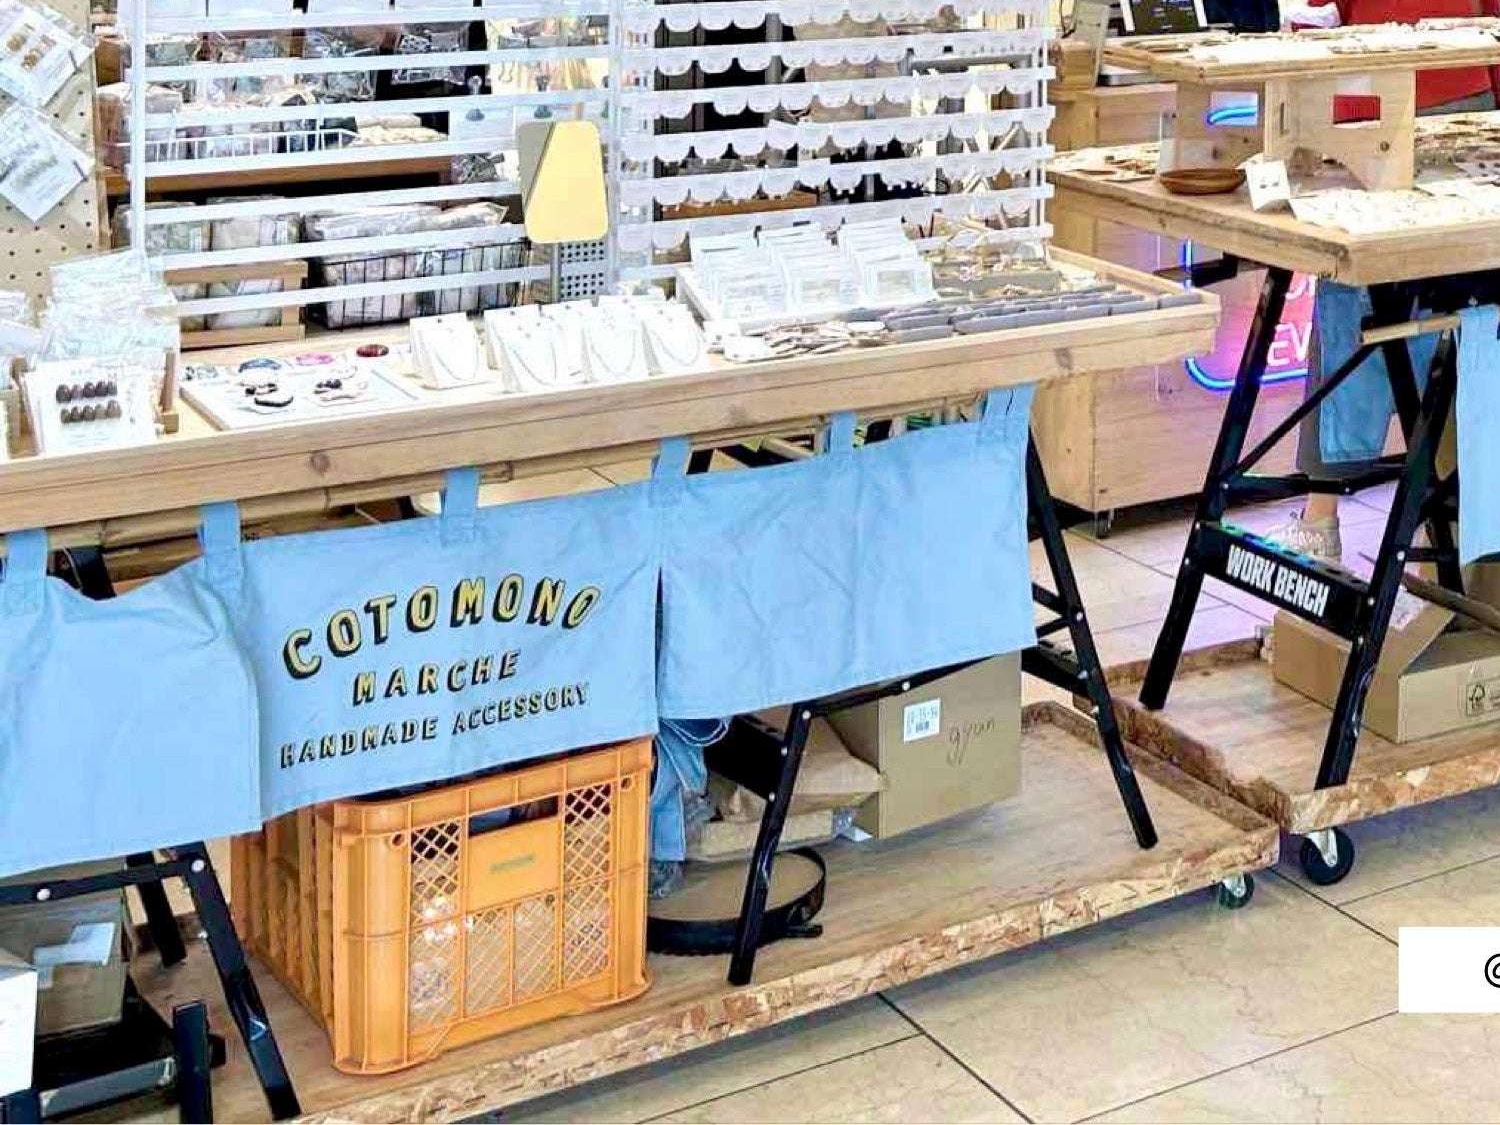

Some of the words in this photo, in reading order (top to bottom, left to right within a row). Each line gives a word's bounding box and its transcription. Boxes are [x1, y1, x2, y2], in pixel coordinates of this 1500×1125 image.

[1225, 544, 1276, 594] WORK
[1274, 565, 1330, 617] BENCH
[283, 573, 601, 679] COTOMONO
[353, 649, 521, 706] MARCHE
[280, 716, 439, 768] HANDMADE
[452, 681, 590, 735] ACCESSORY
